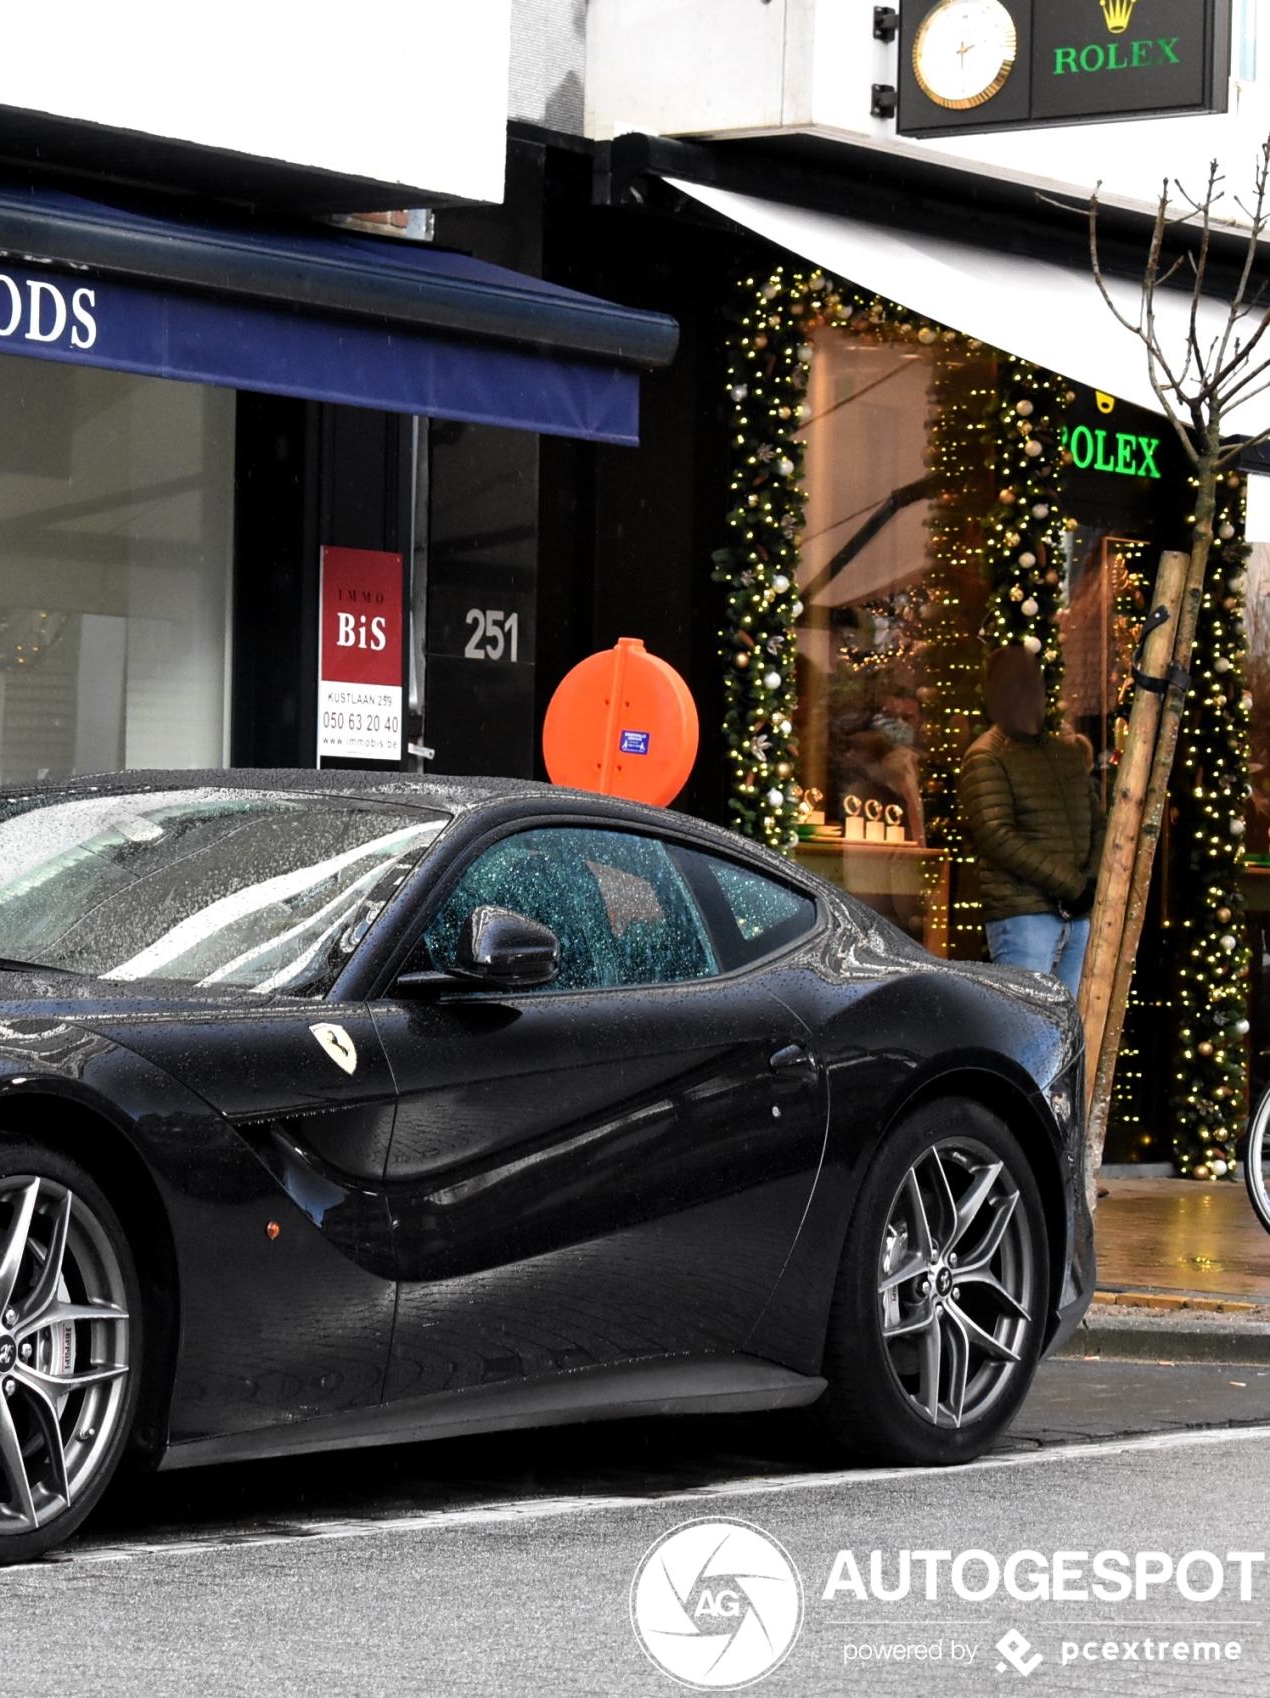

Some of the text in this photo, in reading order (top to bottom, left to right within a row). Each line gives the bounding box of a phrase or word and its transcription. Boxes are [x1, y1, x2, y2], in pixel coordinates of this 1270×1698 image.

[1053, 37, 1181, 75] ROLEX
[1062, 425, 1162, 479] OLEX
[338, 588, 384, 605] IMMO
[336, 612, 387, 651] BiS
[464, 608, 519, 662] 251
[327, 691, 392, 707] KUSTLAAN 259
[323, 711, 399, 733] 050 63 20 40
